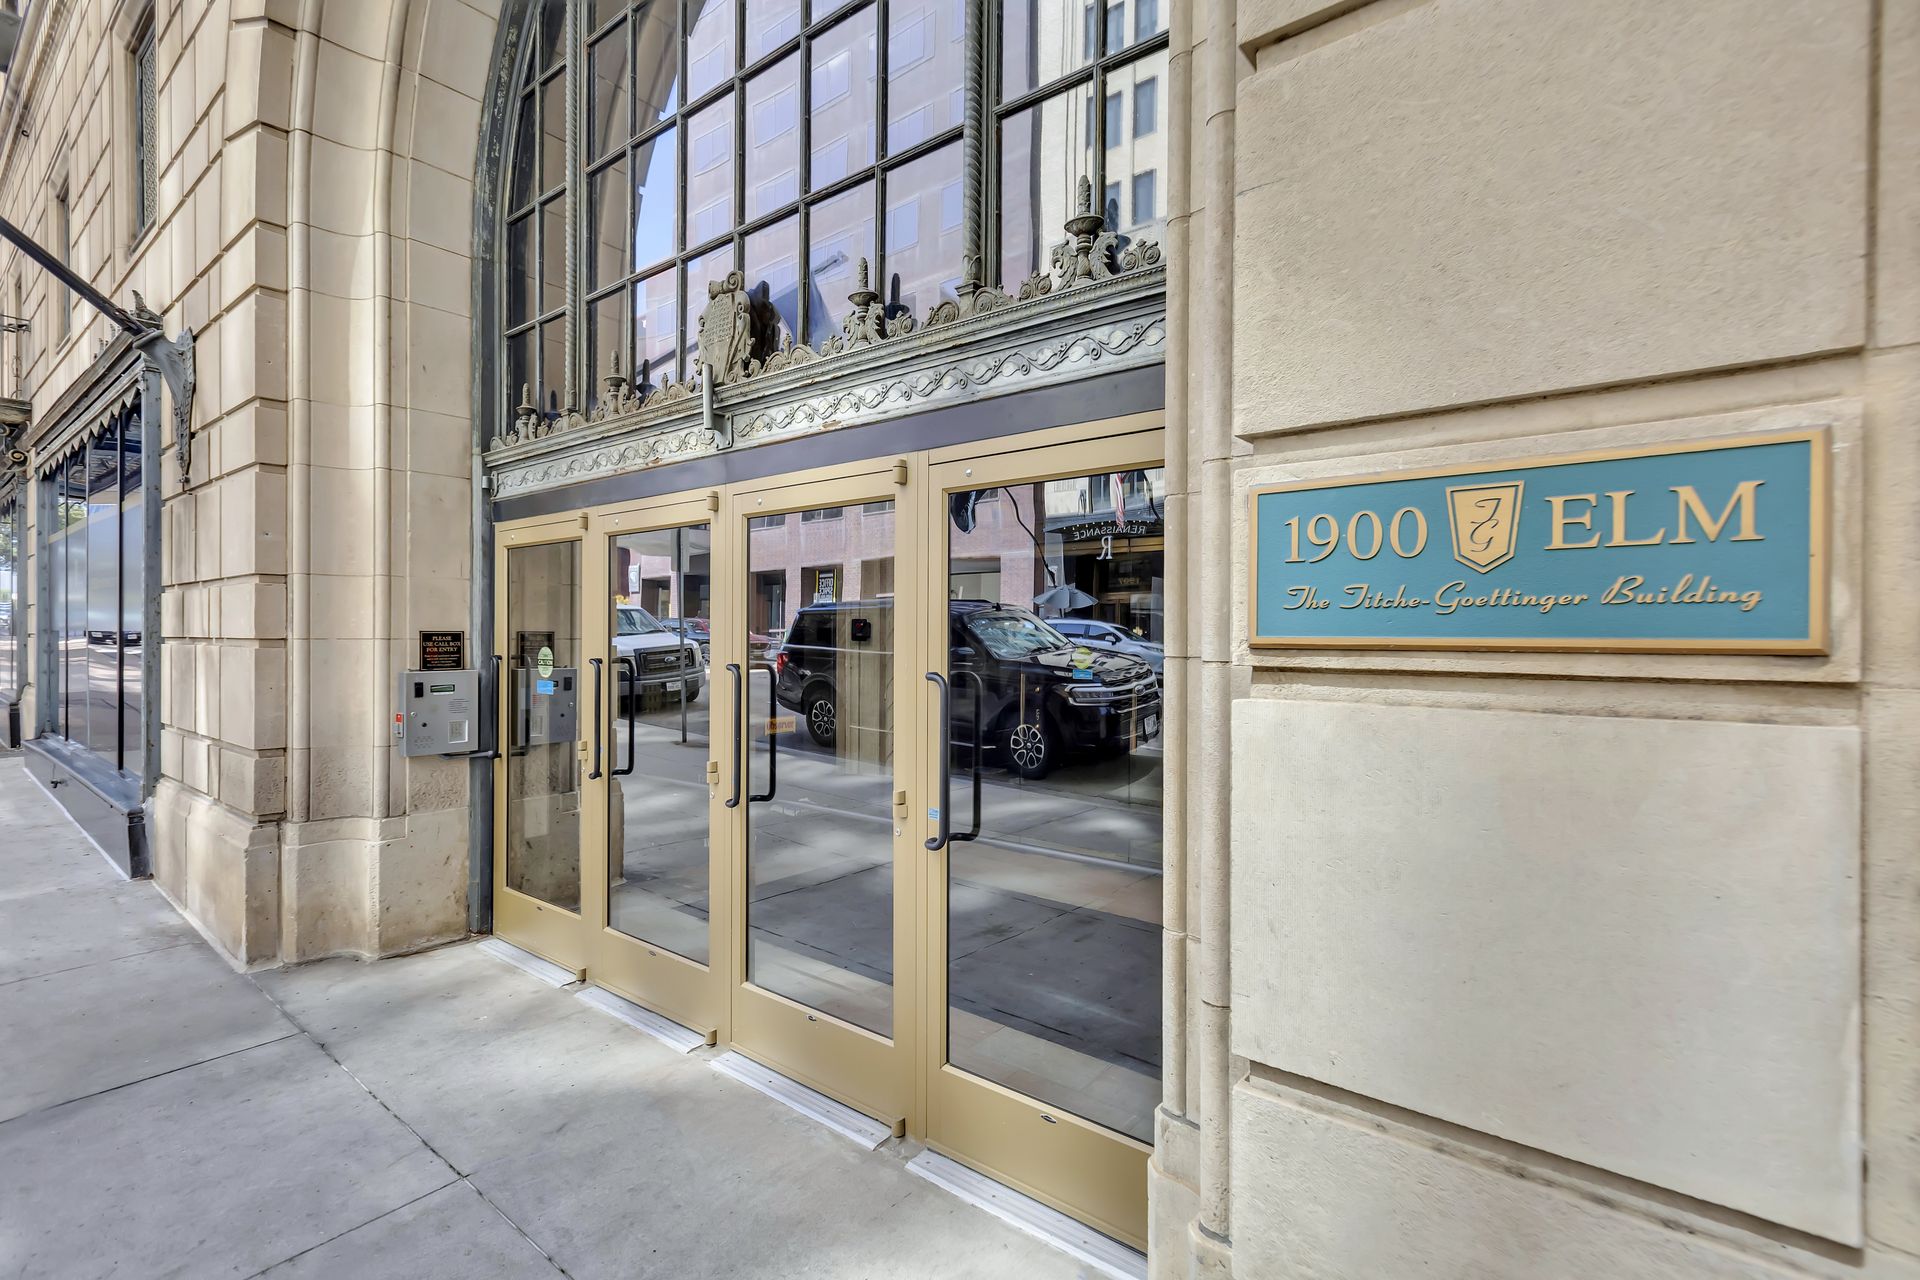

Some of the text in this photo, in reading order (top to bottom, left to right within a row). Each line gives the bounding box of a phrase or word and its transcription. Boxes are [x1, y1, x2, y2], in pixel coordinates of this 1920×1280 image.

[1284, 506, 1428, 563] 1900
[1544, 480, 1766, 550] ELM
[1283, 573, 1763, 615] The Titche-Goettinger Building
